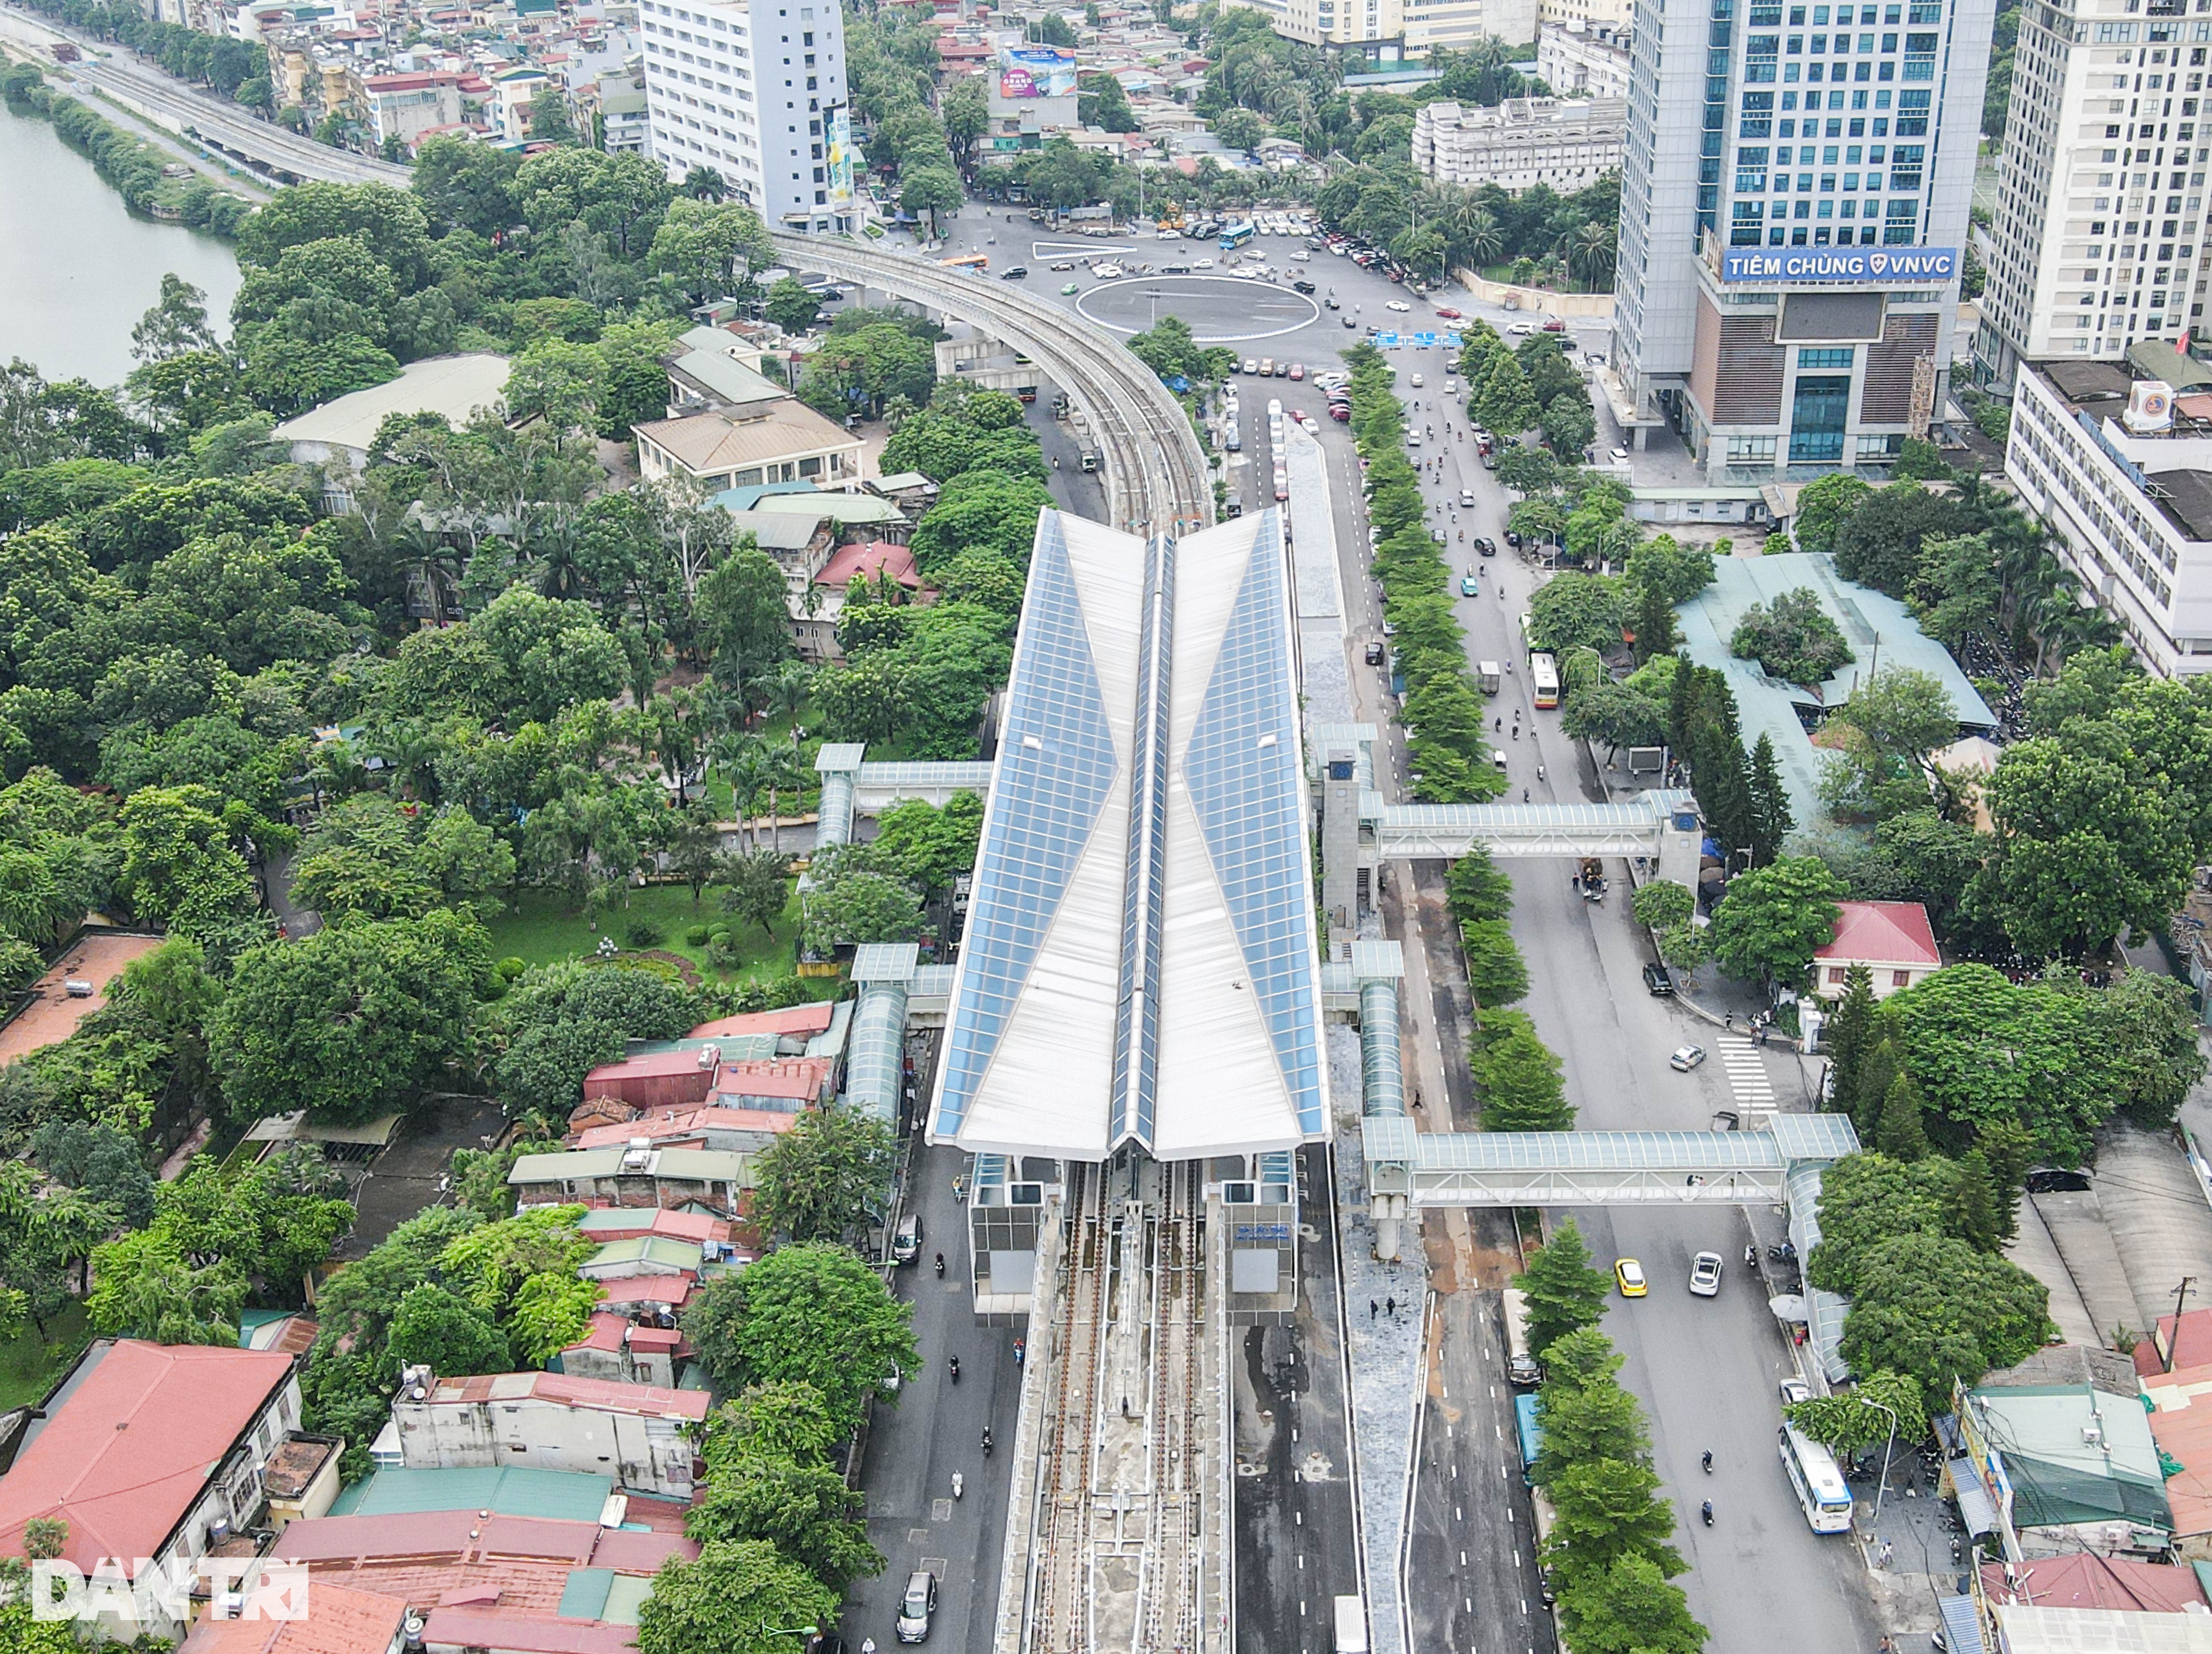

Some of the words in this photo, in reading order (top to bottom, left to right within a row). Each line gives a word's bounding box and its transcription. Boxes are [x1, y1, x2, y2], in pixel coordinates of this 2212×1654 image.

[1729, 254, 1781, 275] TIÊM
[1786, 253, 1864, 275] CHỦNG
[1890, 256, 1951, 274] VNVC
